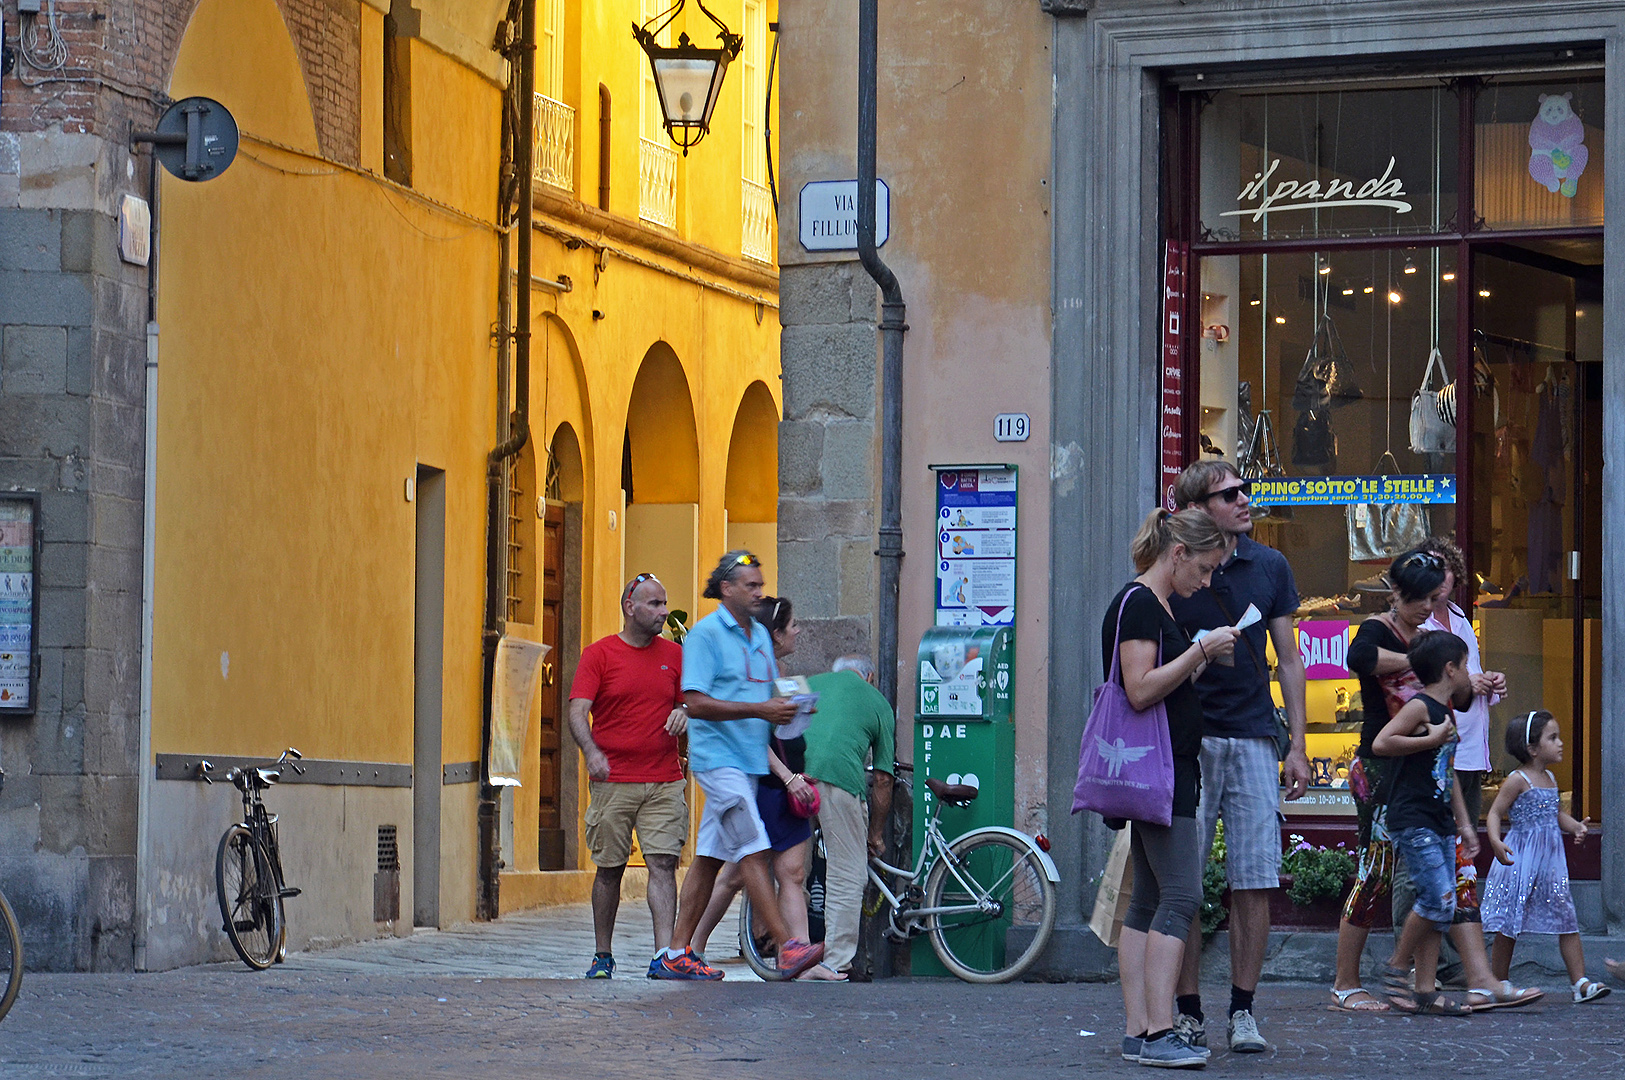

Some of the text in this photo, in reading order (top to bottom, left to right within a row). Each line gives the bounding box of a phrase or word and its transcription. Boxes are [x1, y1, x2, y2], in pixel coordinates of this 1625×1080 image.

[1236, 155, 1406, 223] il panda
[834, 194, 854, 211] VIA
[812, 219, 858, 236] FILLUN
[998, 417, 1025, 437] 119
[1251, 479, 1434, 495] PPING SOTTO LE STELLE
